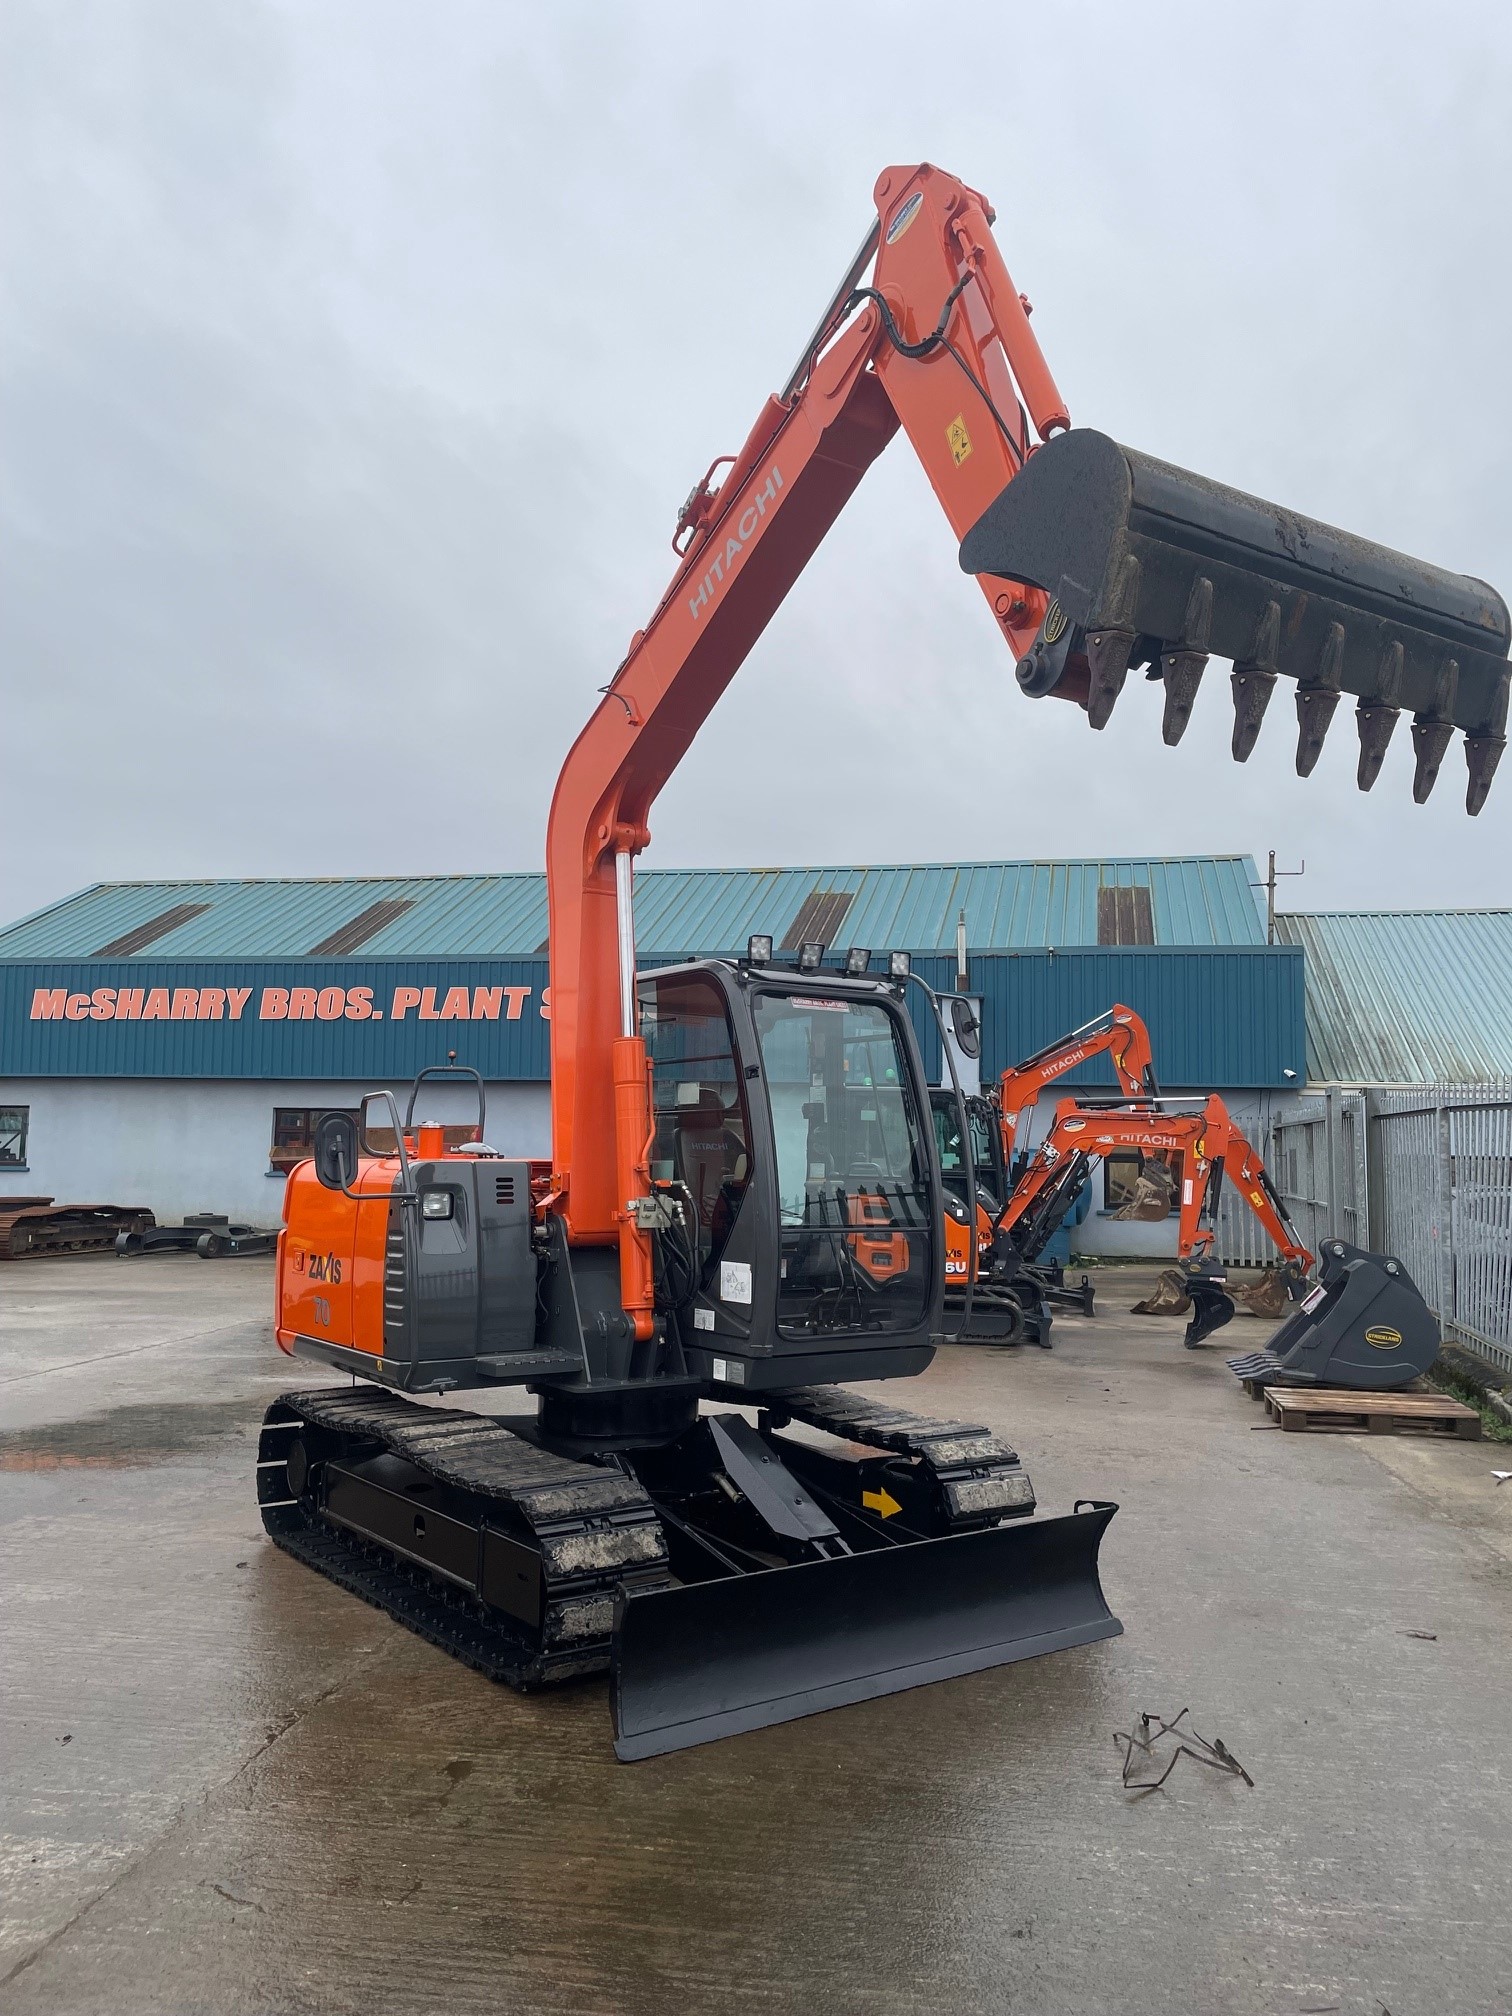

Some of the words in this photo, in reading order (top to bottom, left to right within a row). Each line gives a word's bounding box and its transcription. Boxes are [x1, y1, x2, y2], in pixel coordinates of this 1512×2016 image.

[688, 465, 784, 620] HITACHI
[30, 987, 253, 1020] McSHARRY
[259, 987, 383, 1020] BROS.
[391, 986, 531, 1020] PLANT
[1041, 1050, 1085, 1078] HITACHI
[691, 1142, 729, 1150] HITACHI
[1120, 1133, 1177, 1147] HITACHI
[308, 1251, 342, 1285] ZAXIS
[945, 1261, 967, 1274] 6U
[313, 1296, 330, 1327] 70
